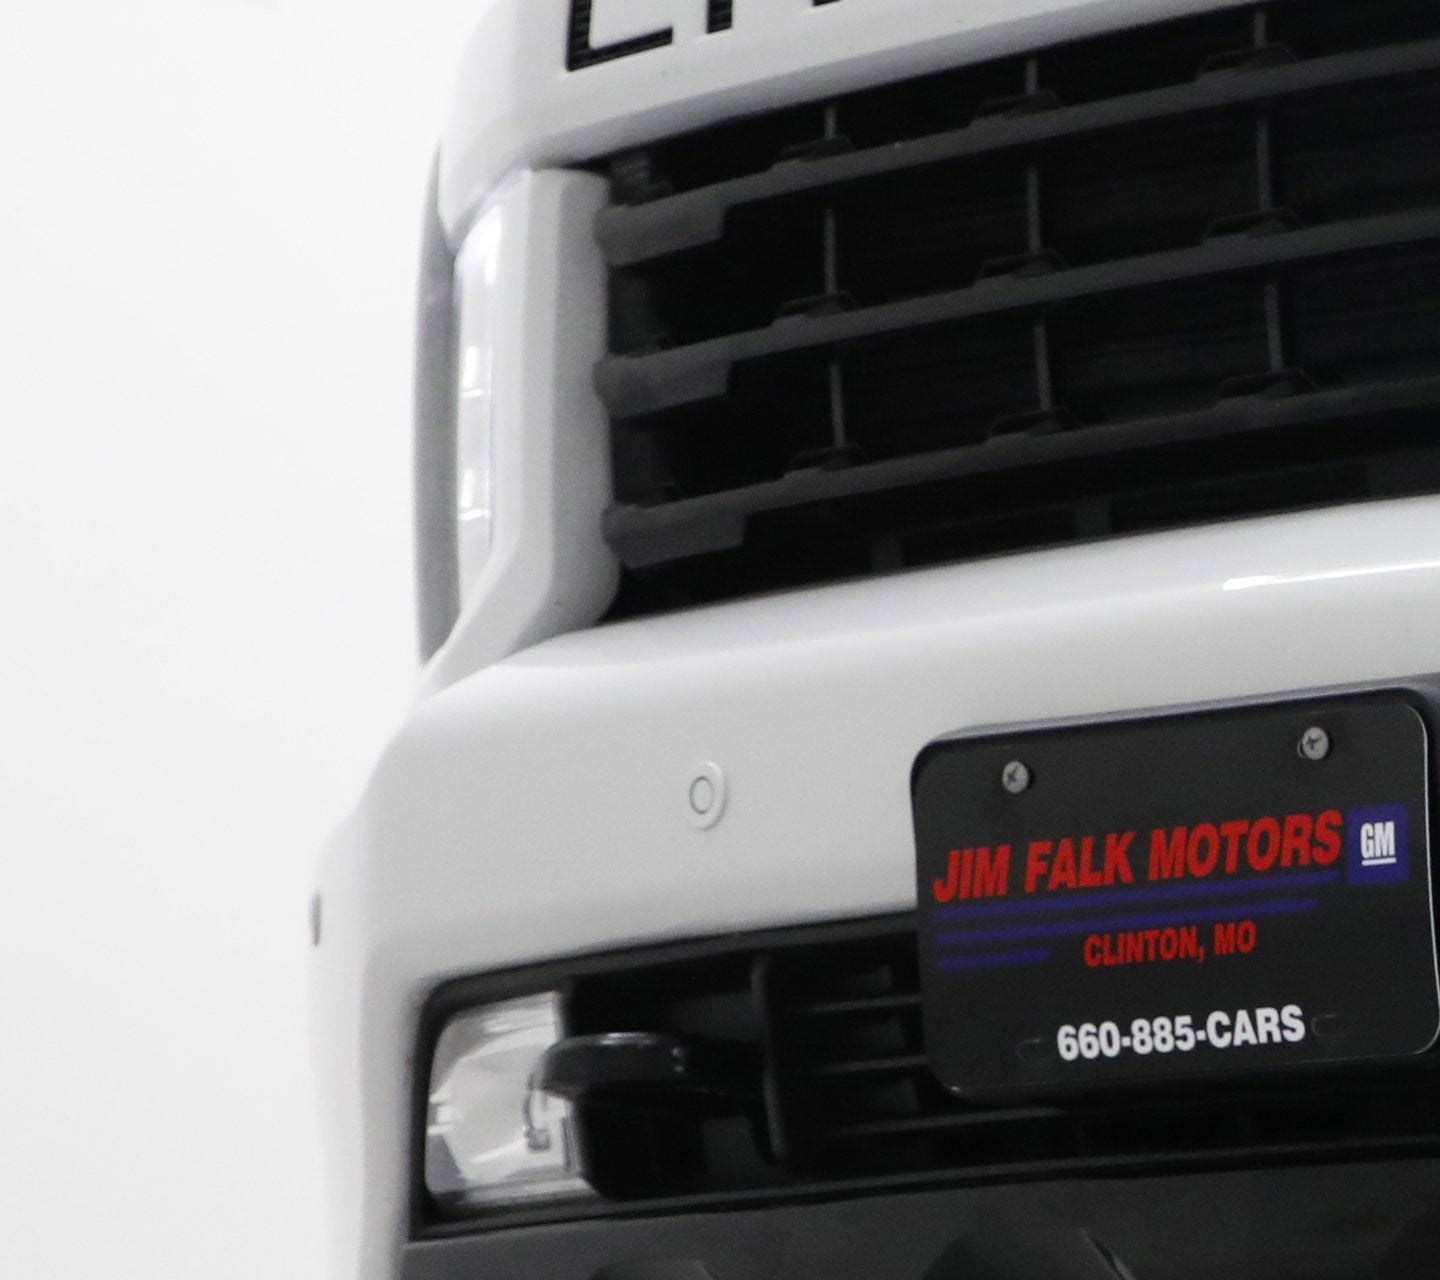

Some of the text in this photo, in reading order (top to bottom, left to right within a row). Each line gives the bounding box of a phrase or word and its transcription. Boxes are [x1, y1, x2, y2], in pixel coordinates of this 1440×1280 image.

[933, 809, 1343, 903] JIM FALK MOTORS
[1359, 821, 1396, 860] GM
[1083, 920, 1257, 967] CLINTON, MO
[1056, 1004, 1306, 1062] 660-885-CARS
